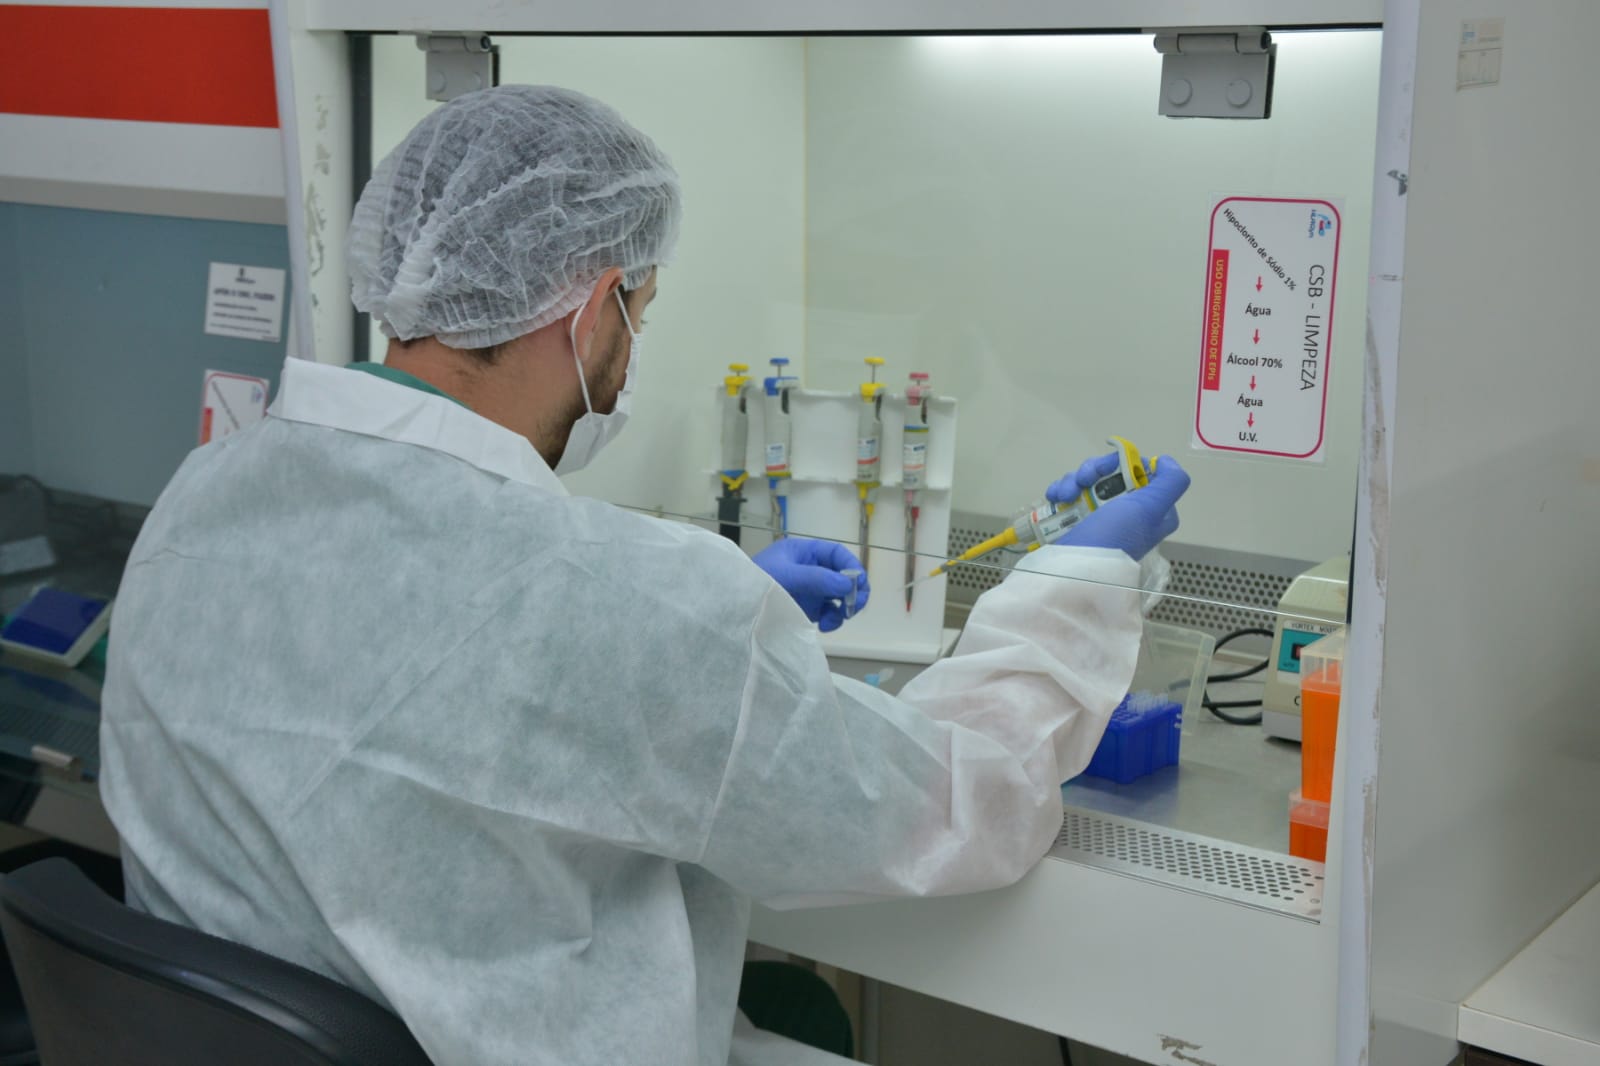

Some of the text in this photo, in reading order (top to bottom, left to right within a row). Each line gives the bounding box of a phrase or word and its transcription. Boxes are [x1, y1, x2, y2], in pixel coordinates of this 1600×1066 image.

[1223, 208, 1297, 291] Hipoclorito de Sódio 1%
[1215, 259, 1224, 280] USO
[1307, 264, 1325, 298] CSB
[1210, 281, 1223, 346] OBRIGATÓRIO
[1245, 302, 1272, 317] Água
[1209, 347, 1217, 360] DE
[1226, 352, 1283, 369] Álcool 70%
[1300, 315, 1321, 391] LIMPEZA
[1237, 393, 1263, 407] Água
[1238, 431, 1258, 442] U.V.
